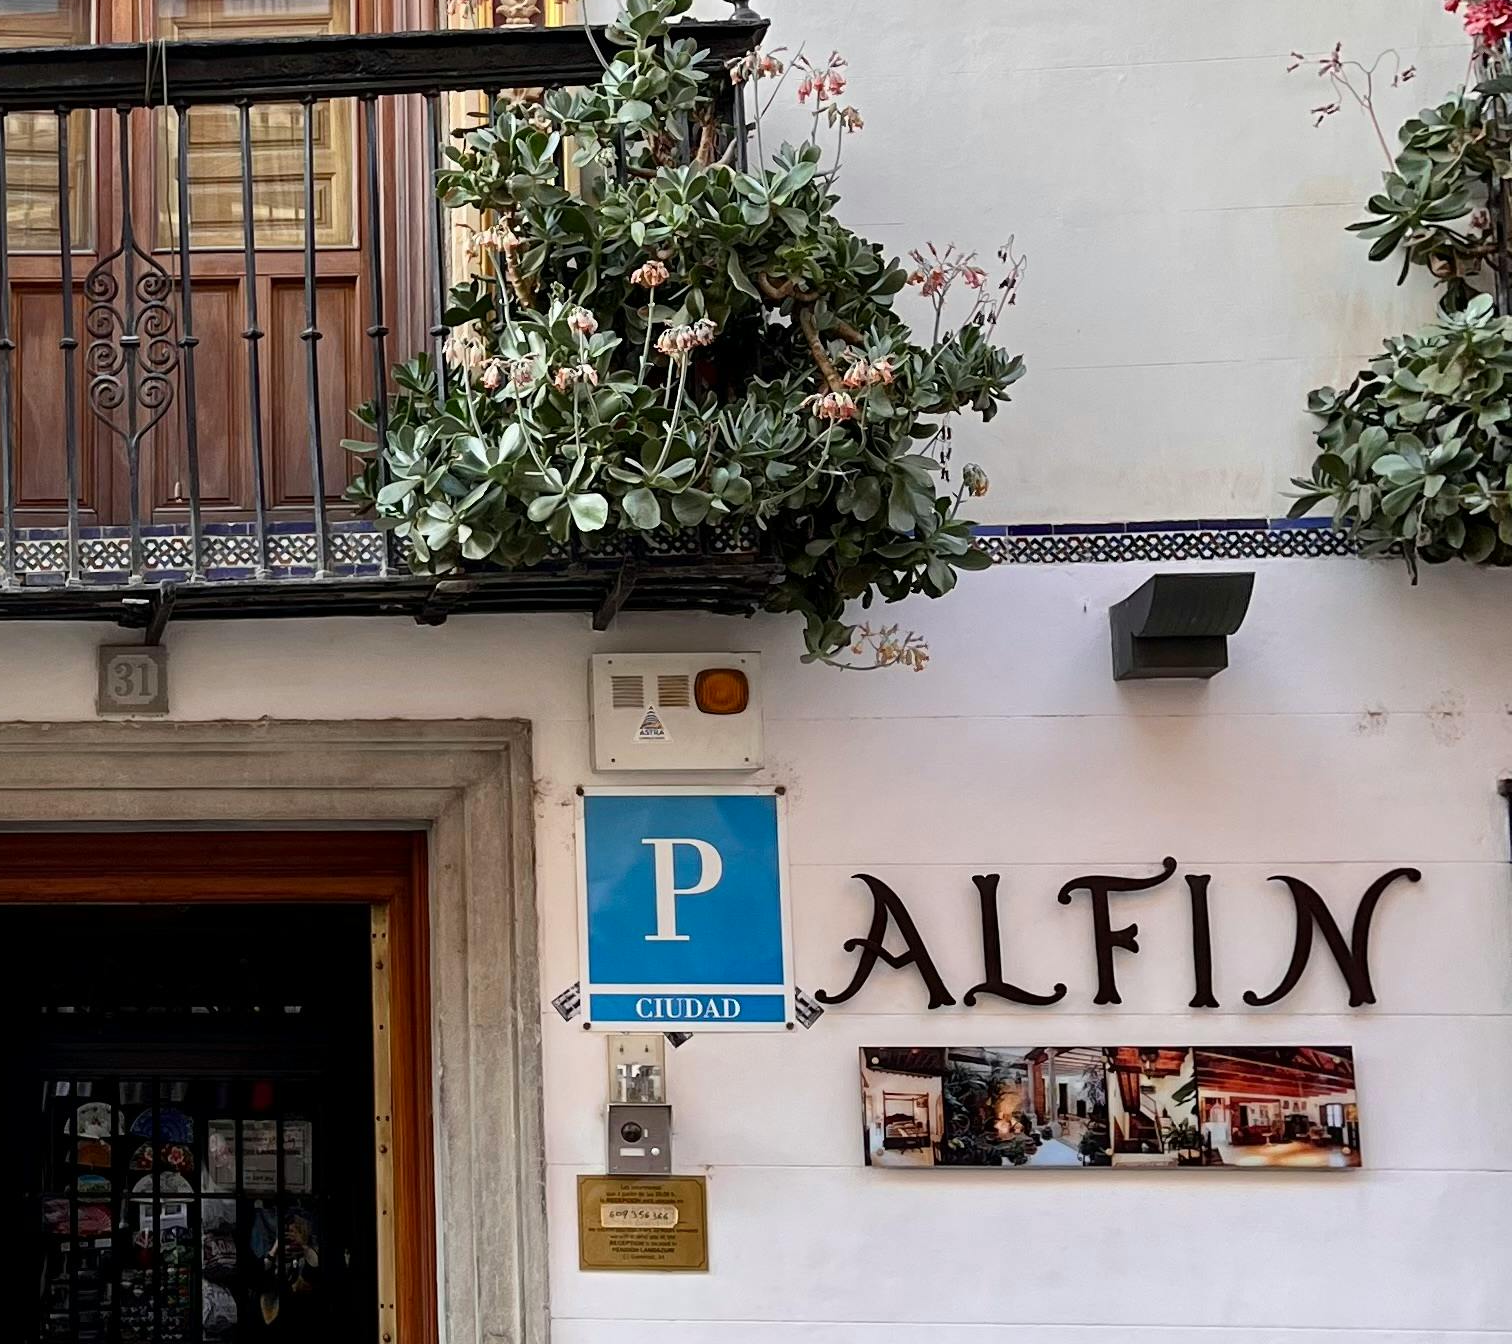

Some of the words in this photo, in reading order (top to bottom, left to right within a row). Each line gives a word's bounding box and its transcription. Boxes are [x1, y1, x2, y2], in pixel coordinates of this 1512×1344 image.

[113, 662, 152, 697] 31
[640, 837, 724, 942] P
[814, 855, 1422, 1009] ALFIN
[635, 996, 741, 1019] CIUDAD
